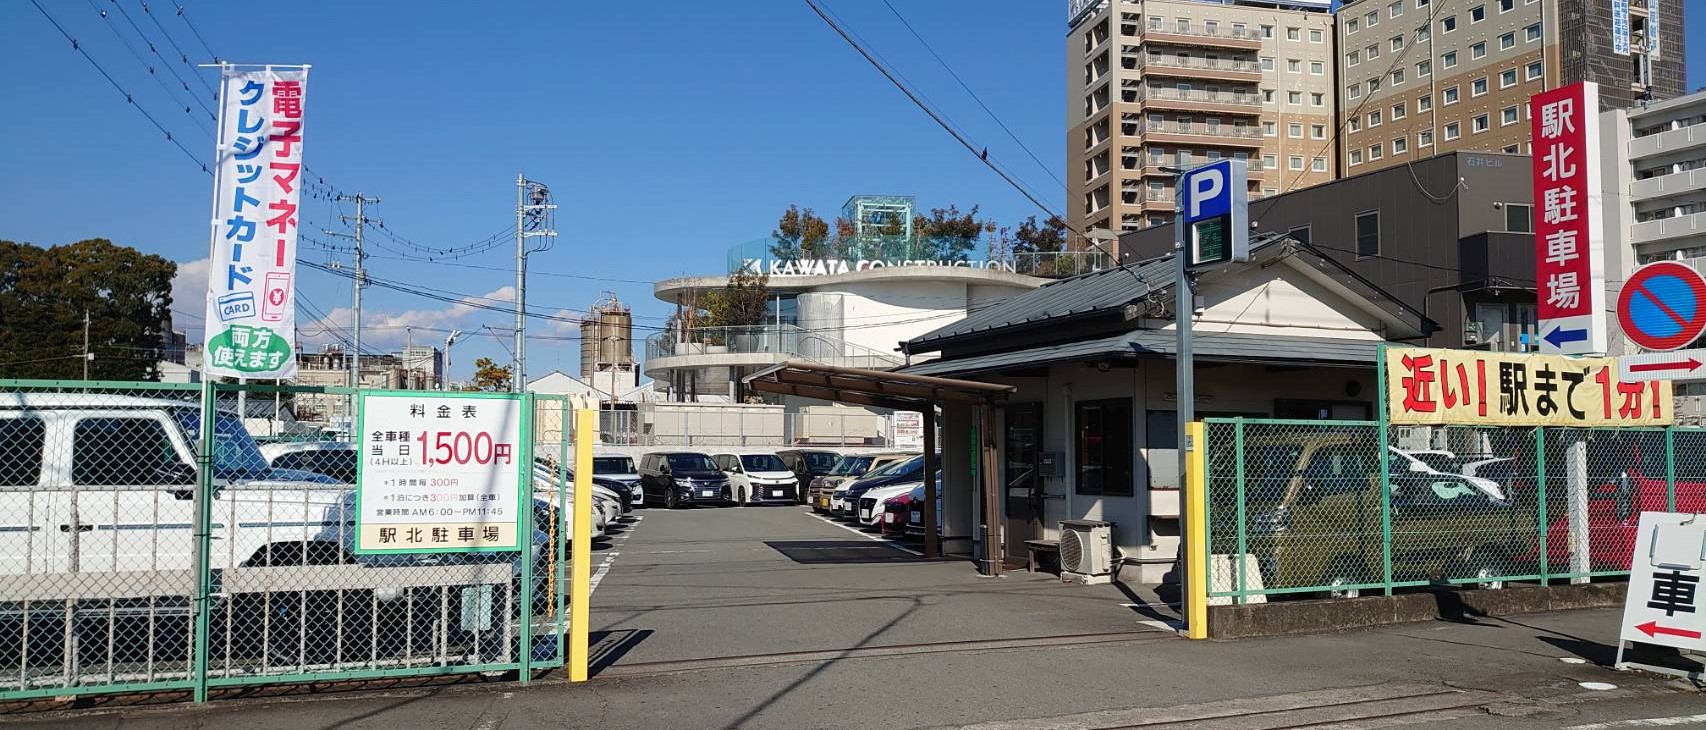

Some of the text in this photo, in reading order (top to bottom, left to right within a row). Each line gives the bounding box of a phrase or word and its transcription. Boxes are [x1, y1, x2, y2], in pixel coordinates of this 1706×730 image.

[266, 80, 302, 267] 電子マネー
[226, 80, 265, 291] クレジットカード
[1191, 169, 1223, 218] P
[1541, 98, 1580, 310] 駅北駐車場
[770, 259, 849, 276] KAWATA
[224, 303, 250, 316] CARD
[231, 327, 272, 349] 両方
[214, 345, 284, 368] 使えます
[410, 403, 477, 419] 料金表
[371, 430, 411, 442] 全車種
[371, 444, 410, 456] 当日
[417, 430, 511, 467] 1,500円
[378, 525, 500, 543] 駅北駐車場
[1647, 570, 1700, 617] 車
